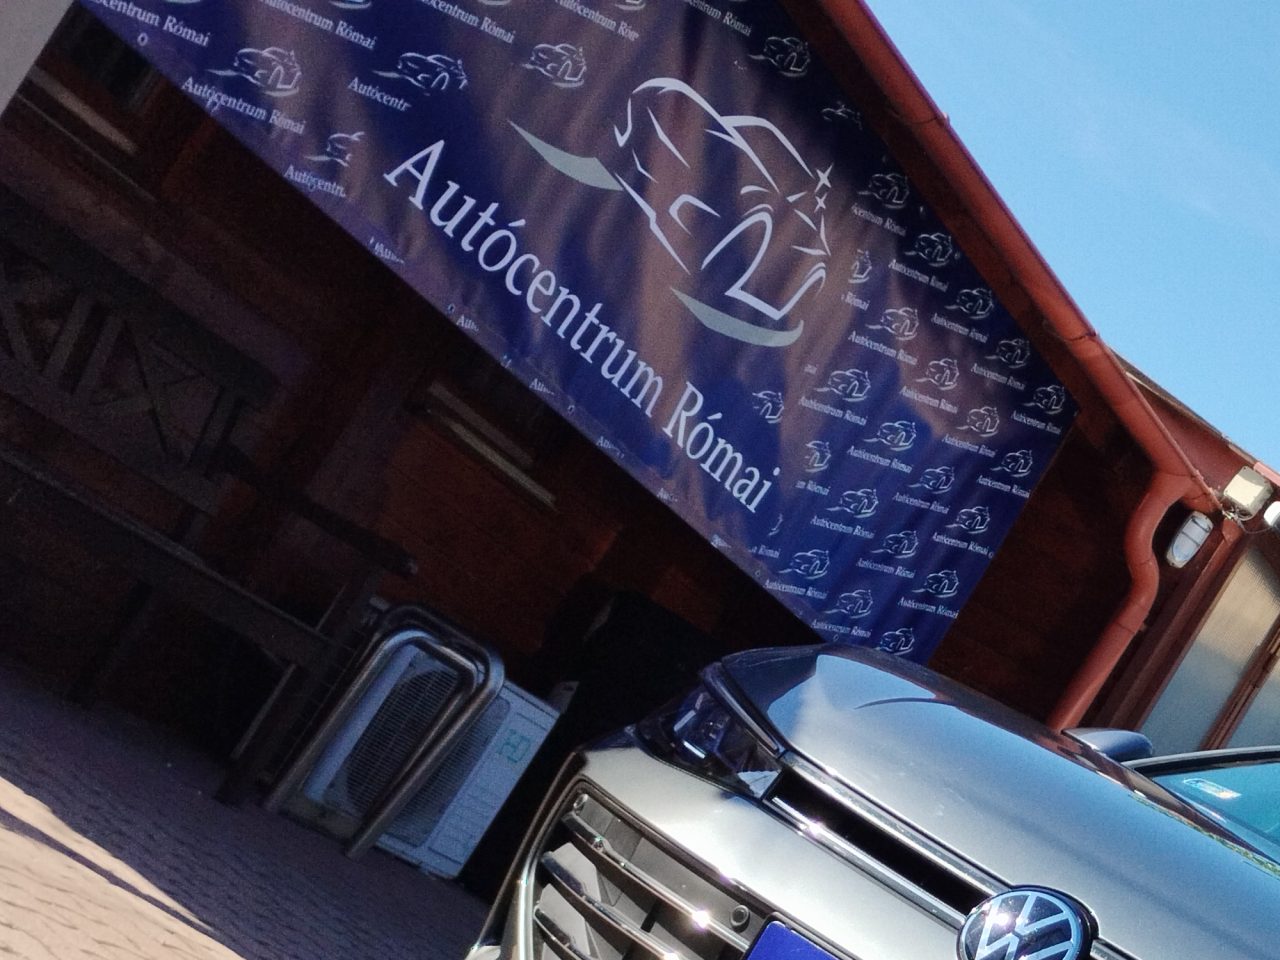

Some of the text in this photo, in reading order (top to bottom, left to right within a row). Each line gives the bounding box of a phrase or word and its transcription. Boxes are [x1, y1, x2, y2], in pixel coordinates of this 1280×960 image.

[163, 15, 210, 47] Római
[335, 20, 378, 50] Római
[182, 76, 267, 121] Autócentrum
[383, 139, 781, 514] Autócentrum Római
